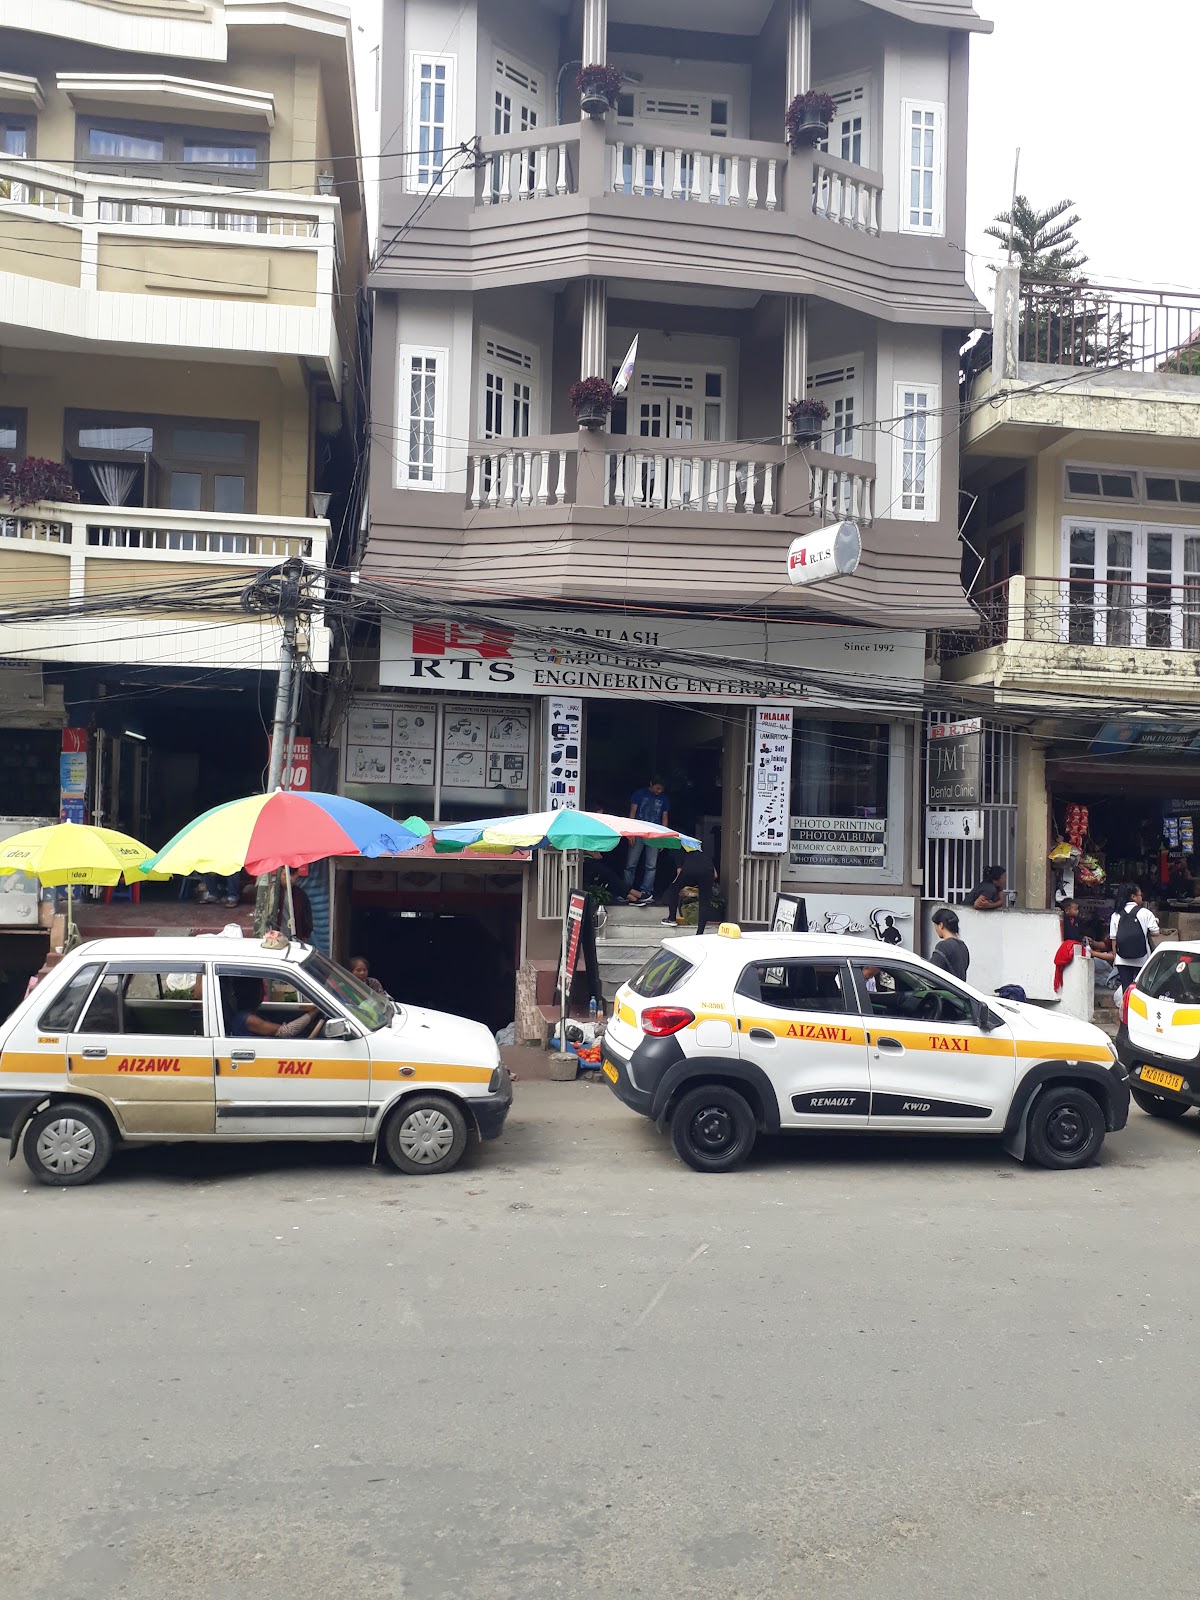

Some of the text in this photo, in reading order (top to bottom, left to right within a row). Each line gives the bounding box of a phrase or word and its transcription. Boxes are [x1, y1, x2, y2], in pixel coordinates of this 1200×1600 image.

[809, 548, 832, 564] R.T.S
[594, 629, 660, 646] FLASH
[843, 642, 895, 652] Since 1992
[409, 656, 516, 682] RTS
[534, 669, 679, 690] ENGINEERING
[759, 712, 790, 721] THLALAK
[936, 744, 969, 779] JMT
[930, 784, 975, 798] Dental Clinic
[793, 818, 882, 831] PHOTO PRINTING
[799, 830, 875, 842] PHOTO ALBUM
[791, 843, 825, 851] MEMORY
[849, 845, 882, 853] BATTERY
[786, 1023, 970, 1051] AIZAWL TAXI
[118, 1058, 313, 1075] AIZAWL TAXI
[810, 1098, 931, 1112] RENAULT KWID
